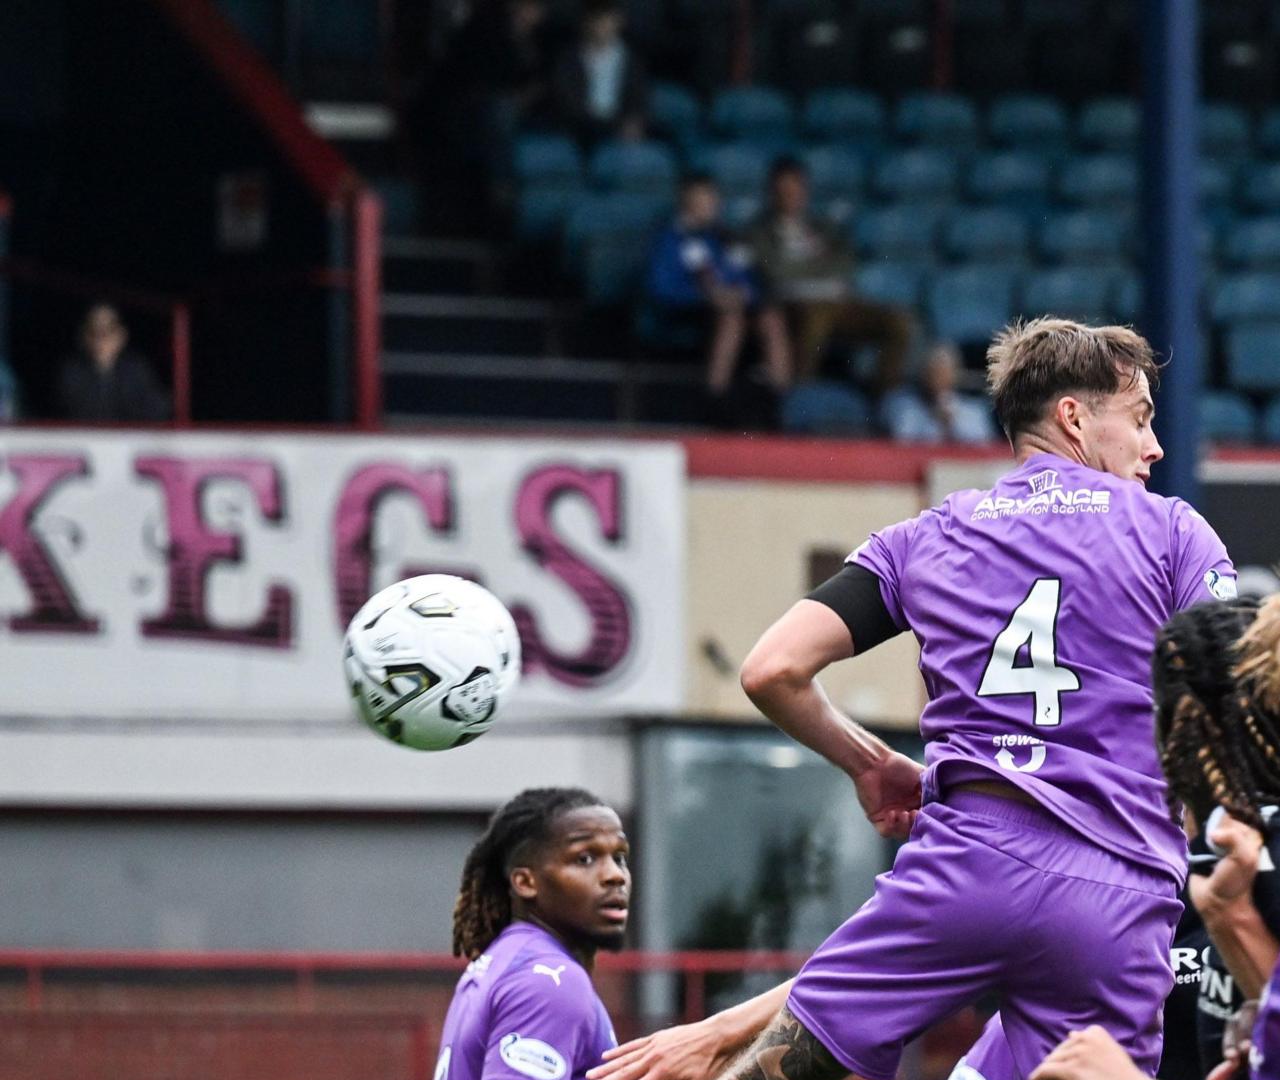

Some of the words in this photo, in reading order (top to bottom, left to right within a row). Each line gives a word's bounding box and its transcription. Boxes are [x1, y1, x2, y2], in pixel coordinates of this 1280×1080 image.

[970, 504, 1049, 521] CONSTRUCTION
[1051, 503, 1110, 514] SCOTLAND
[975, 488, 1111, 512] ADVANCE
[976, 577, 1082, 727] 4
